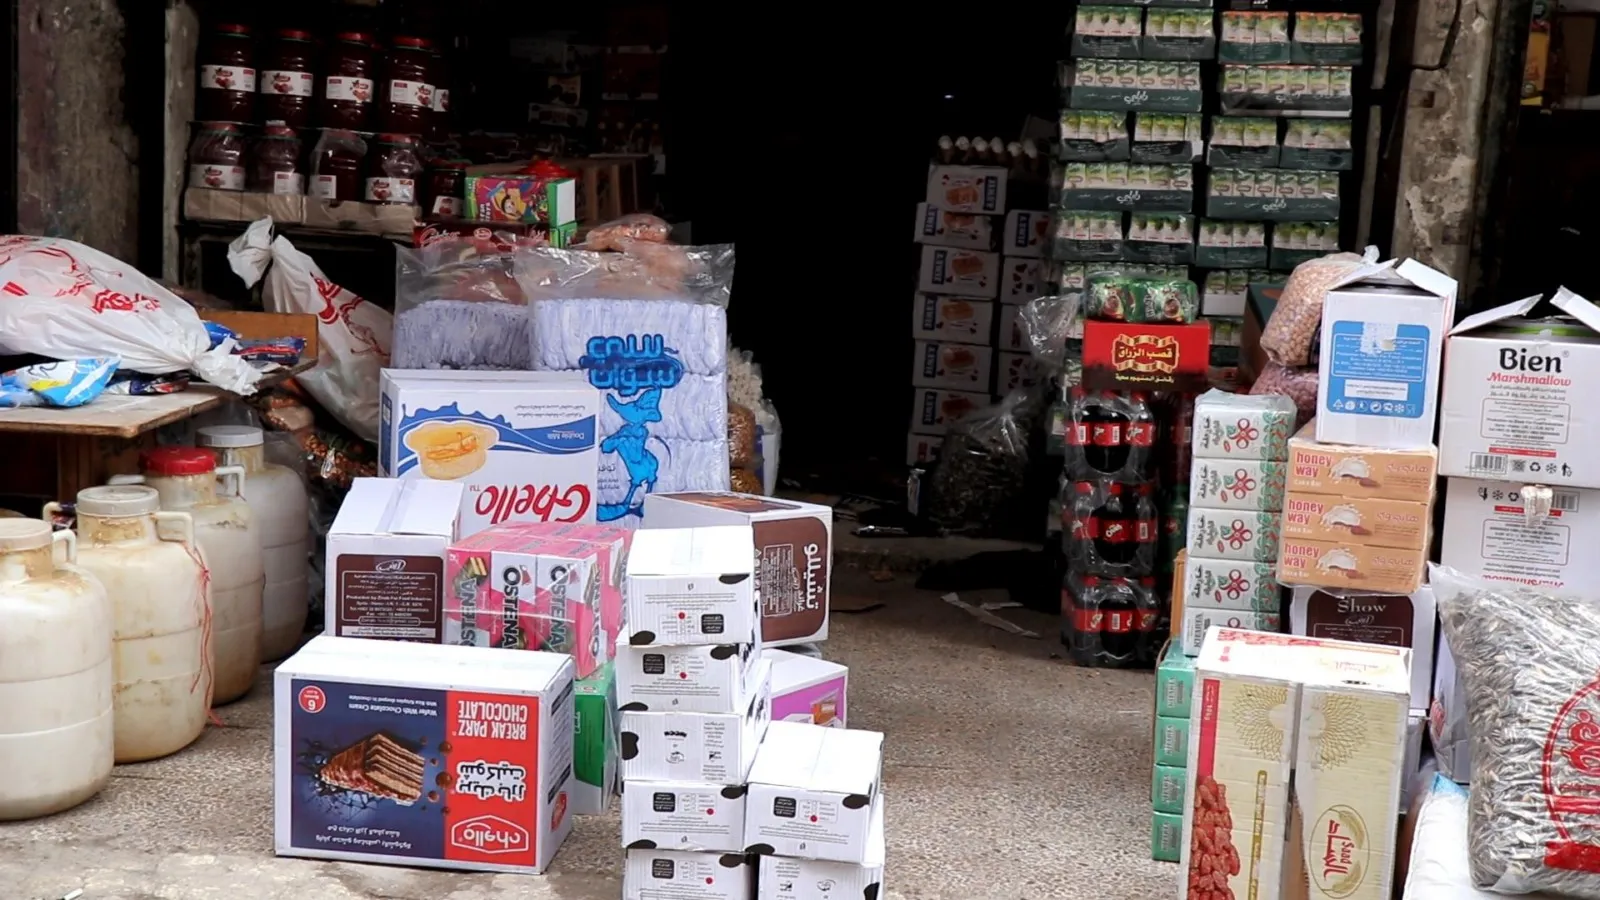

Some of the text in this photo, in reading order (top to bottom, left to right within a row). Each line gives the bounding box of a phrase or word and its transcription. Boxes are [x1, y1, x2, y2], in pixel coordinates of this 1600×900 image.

[1499, 347, 1562, 373] Bien
[1487, 372, 1571, 387] Marshmallow
[1296, 452, 1332, 467] honey
[1296, 465, 1319, 478] way
[1288, 499, 1324, 514] honey
[1287, 512, 1310, 525] way
[1284, 543, 1320, 558] honey
[1283, 556, 1307, 569] way
[460, 578, 478, 647] OSTENA
[503, 566, 521, 649] OSTENA
[550, 565, 567, 649] OSTENA
[1337, 598, 1387, 613] Show
[308, 700, 316, 711] 6
[349, 703, 437, 717] Wafer With Chocolate Cream
[458, 700, 528, 723] CHOCOLATE
[458, 720, 526, 740] BREAK PARZ
[1339, 840, 1355, 865] Saad
